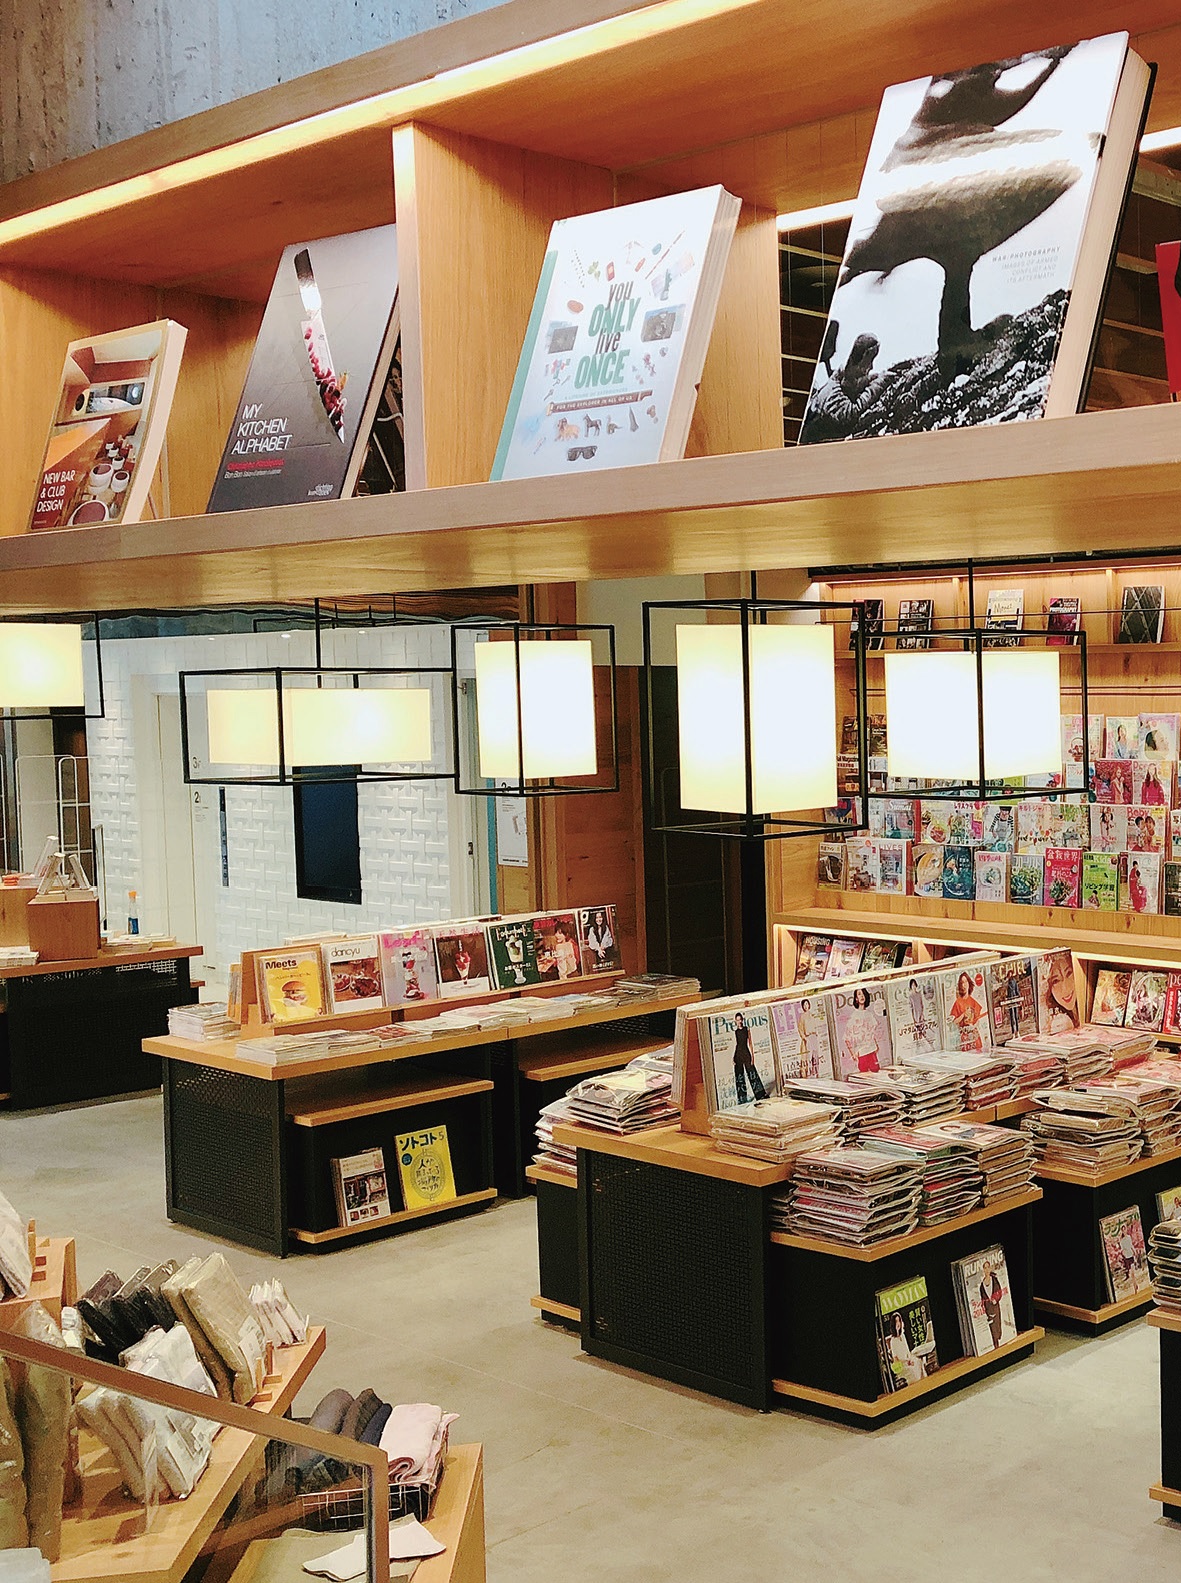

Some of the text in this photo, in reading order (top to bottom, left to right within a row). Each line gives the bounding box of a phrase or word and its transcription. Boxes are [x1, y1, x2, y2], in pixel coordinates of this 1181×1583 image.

[1010, 246, 1061, 259] PHOTOGRAPHY
[605, 281, 634, 311] you
[588, 297, 641, 337] ONLY
[594, 328, 621, 355] live
[574, 349, 631, 389] ONCE
[243, 404, 262, 420] MY
[237, 417, 288, 437] KITCHEN
[231, 434, 293, 455] ALPHABET
[43, 469, 76, 485] NEW BAR
[40, 485, 66, 499] & CLUB
[36, 499, 64, 513] DESIGN
[330, 946, 361, 958] dancyu
[265, 959, 298, 970] Meets
[714, 1013, 768, 1036] Preious
[399, 1131, 438, 1152] ソトコト
